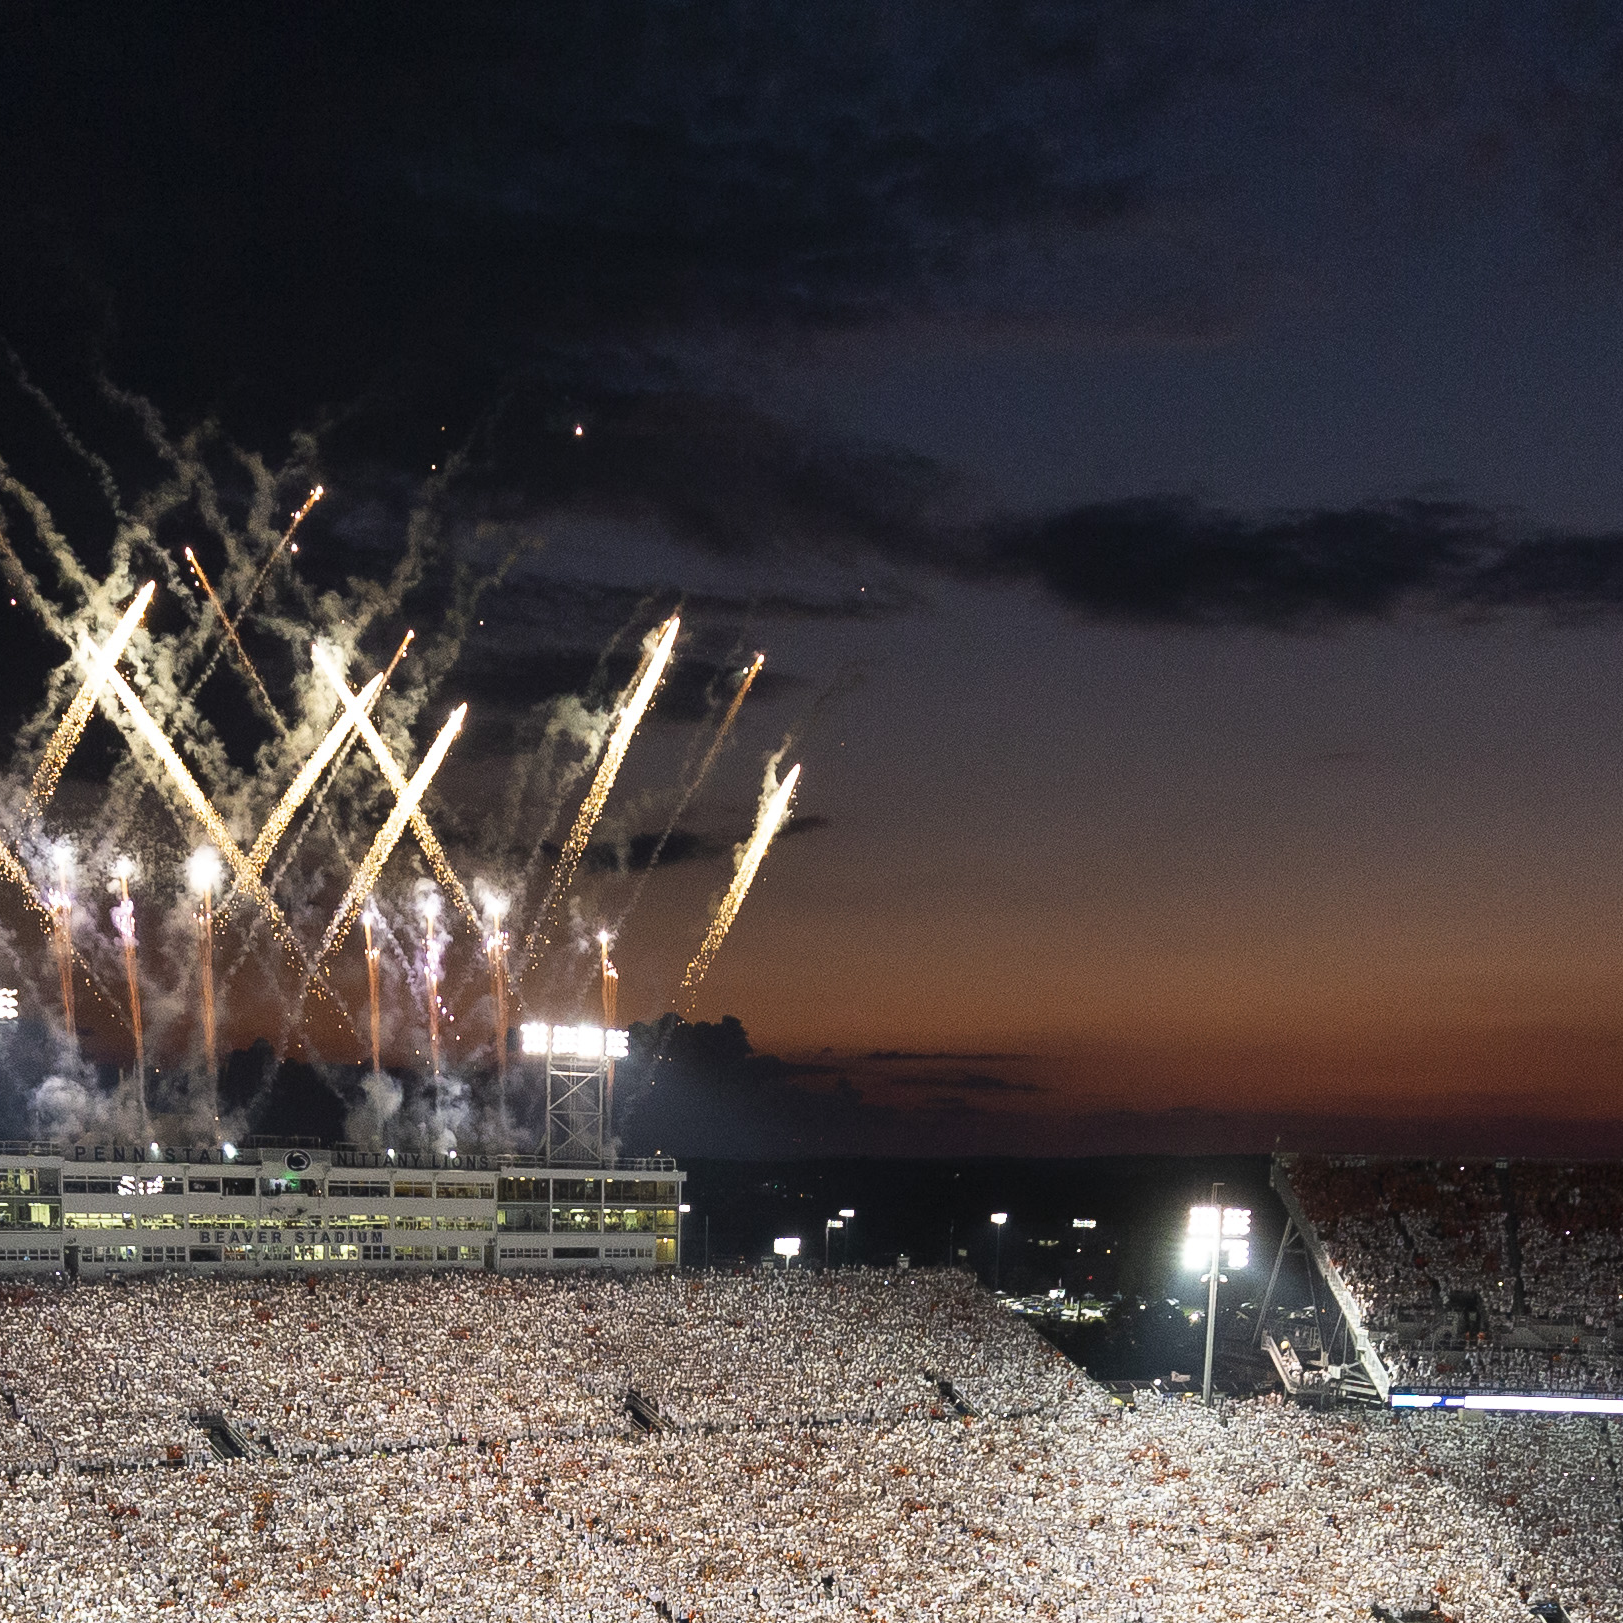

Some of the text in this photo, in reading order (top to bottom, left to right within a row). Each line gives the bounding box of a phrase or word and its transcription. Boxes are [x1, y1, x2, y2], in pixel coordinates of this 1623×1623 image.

[73, 1146, 154, 1161] PENN
[336, 1152, 488, 1168] NITTANY LIONS
[200, 1230, 383, 1245] BEAVER STADIUM
